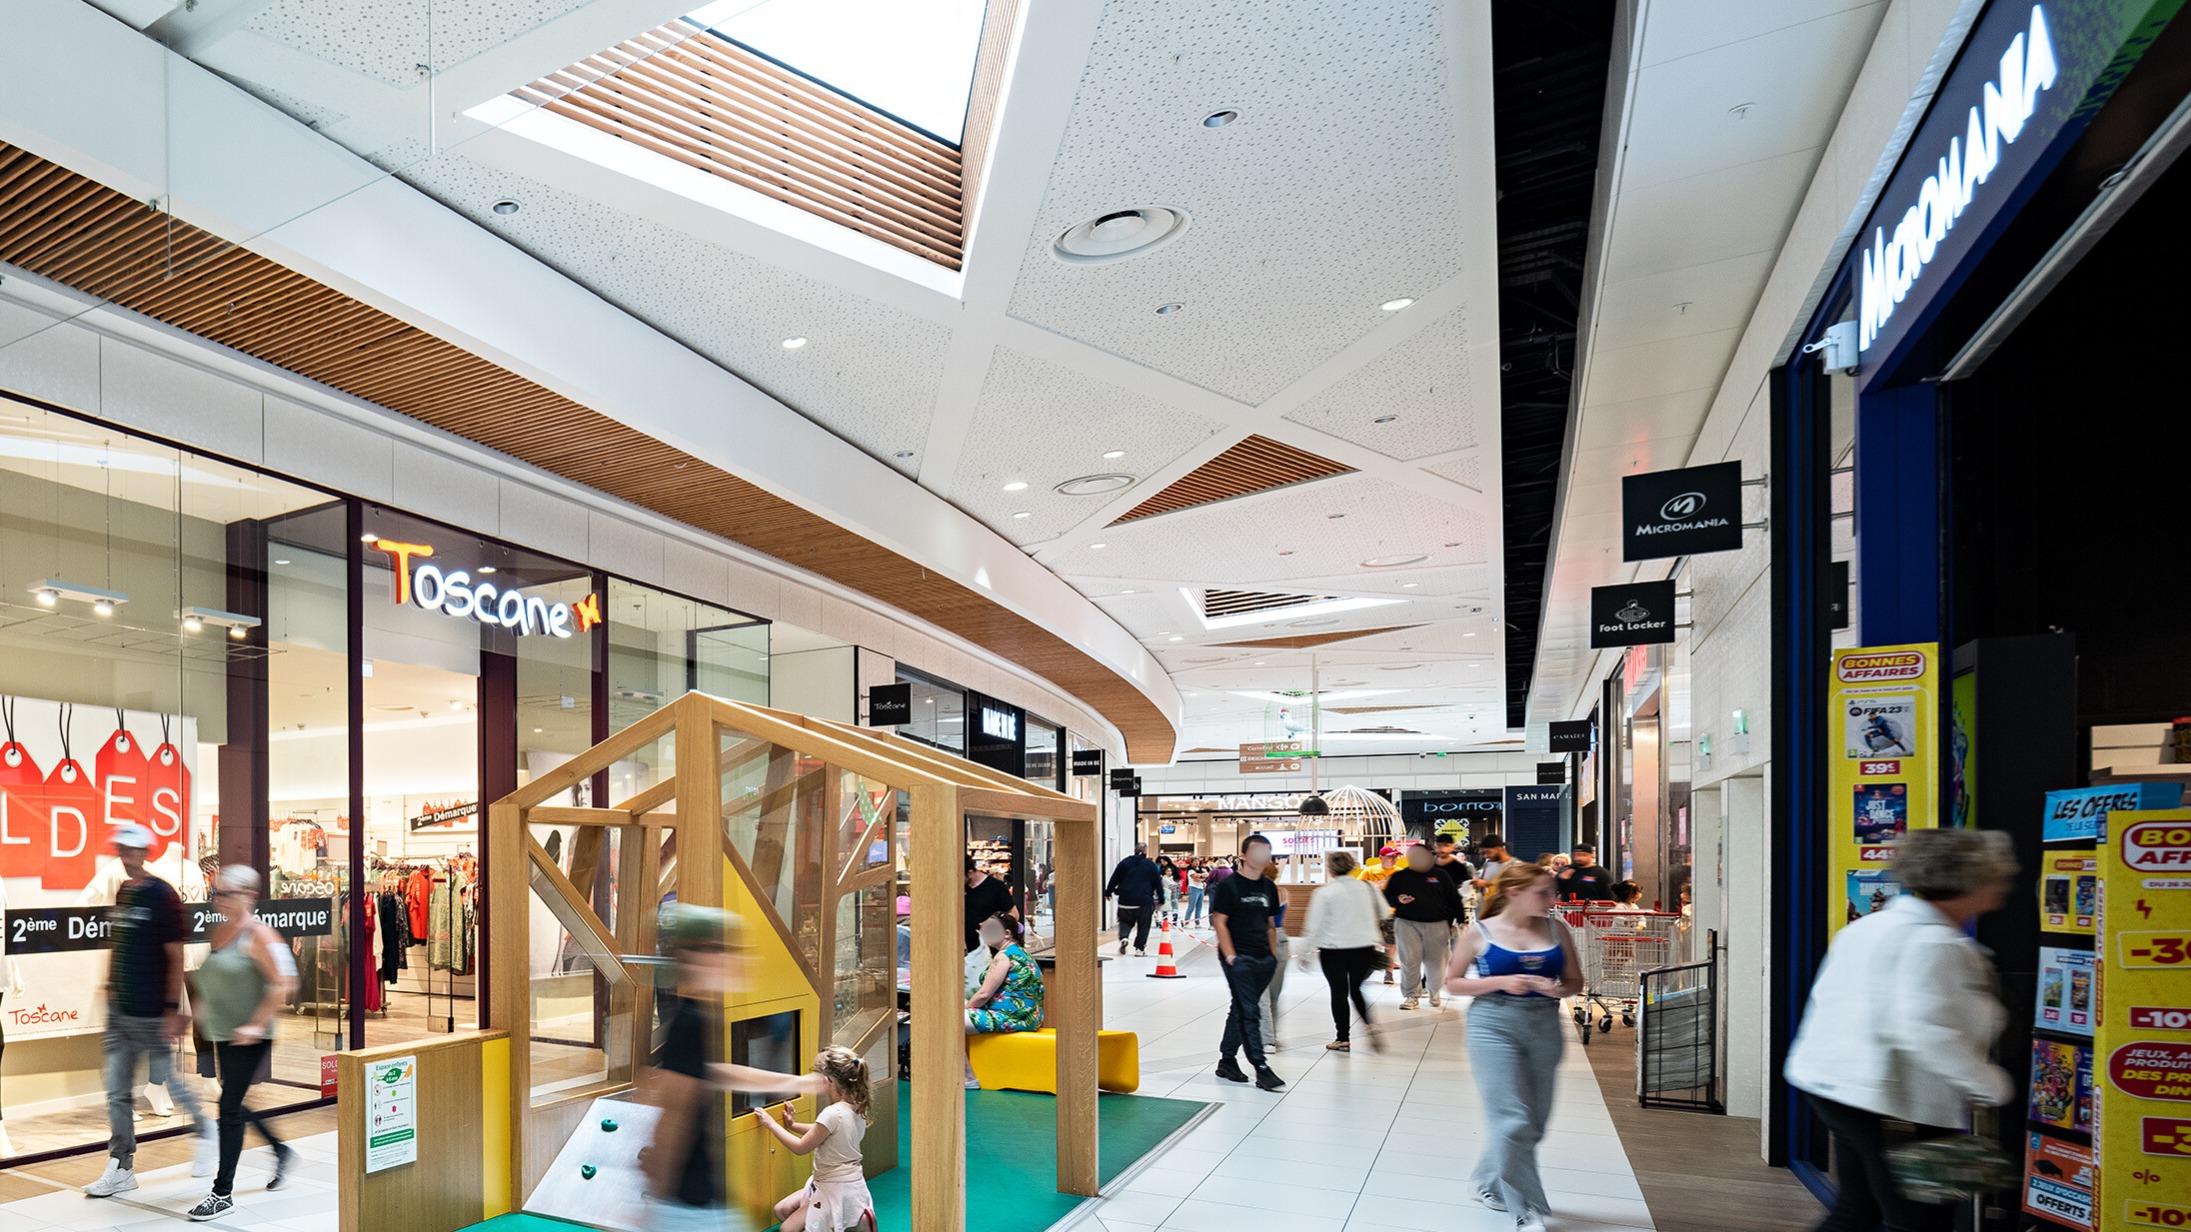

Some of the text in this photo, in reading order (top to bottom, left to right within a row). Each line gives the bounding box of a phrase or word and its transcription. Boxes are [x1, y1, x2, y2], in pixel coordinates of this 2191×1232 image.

[1859, 4, 2058, 352] MICROMANIA
[1635, 518, 1729, 536] MICROMANIA
[373, 537, 573, 638] Toscane
[1599, 621, 1666, 632] Foot Locker
[1844, 655, 1917, 669] BONNES
[1843, 666, 1919, 679] AFFAIRES
[1888, 706, 1902, 714] 23
[1218, 797, 1301, 809] MANGO
[2052, 792, 2138, 820] LES OFFRES
[434, 804, 477, 822] Démarque
[252, 908, 329, 931] émarque
[12, 917, 57, 942] 2ème
[8, 1008, 79, 1025] Toscane
[2138, 1010, 2191, 1028] -10
[2121, 1069, 2163, 1081] DES
[2154, 1085, 2191, 1096] DIN
[2037, 1193, 2086, 1218] OFFERTS
